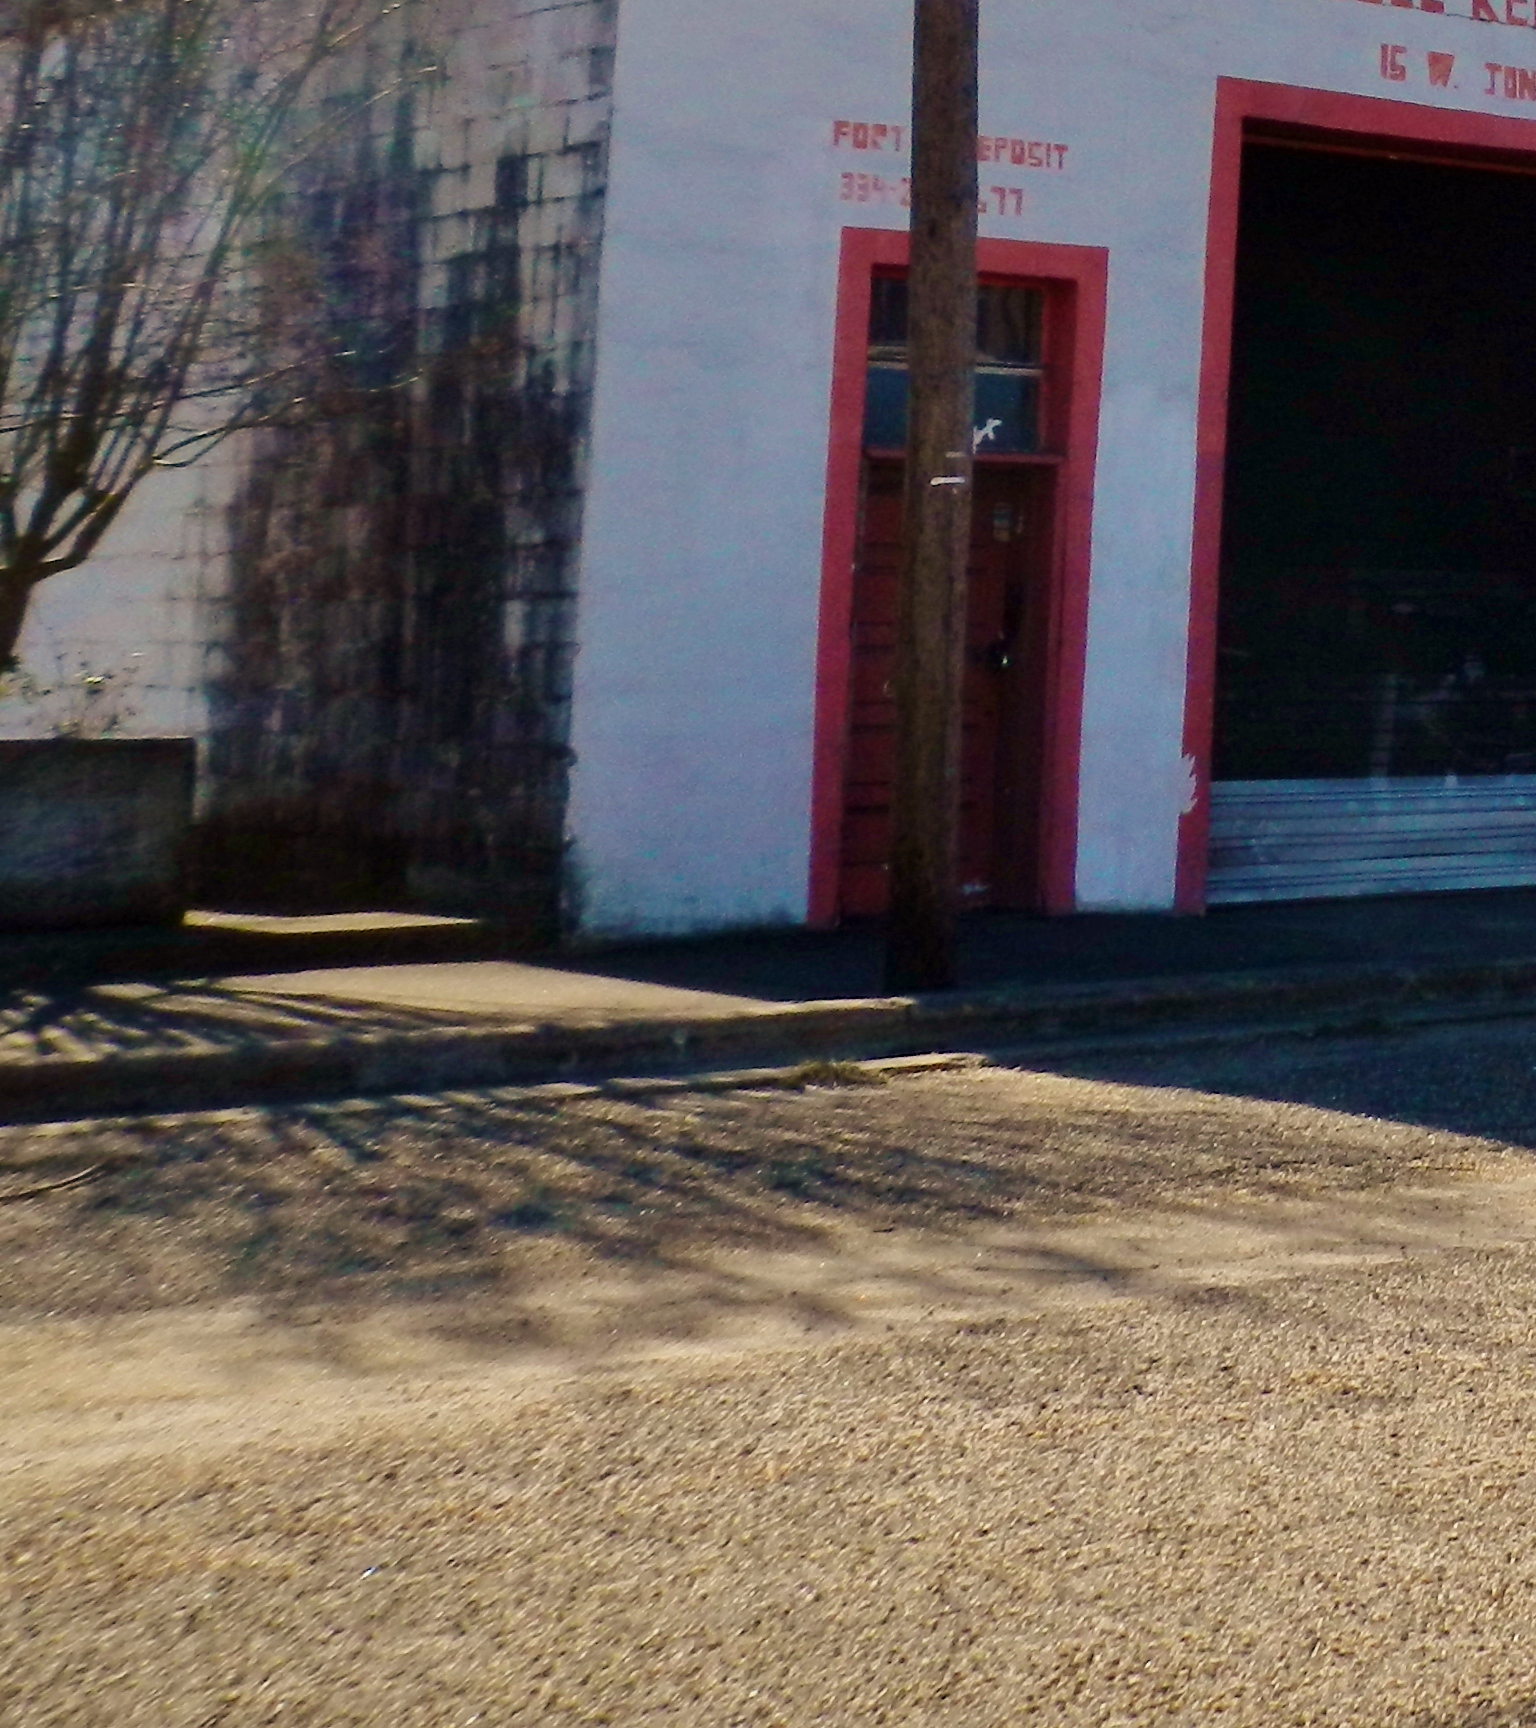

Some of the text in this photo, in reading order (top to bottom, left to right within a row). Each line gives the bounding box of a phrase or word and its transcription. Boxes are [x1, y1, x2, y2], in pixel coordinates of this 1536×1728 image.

[1426, 50, 1459, 89] W.
[832, 120, 1069, 171] FORT EPOSIT
